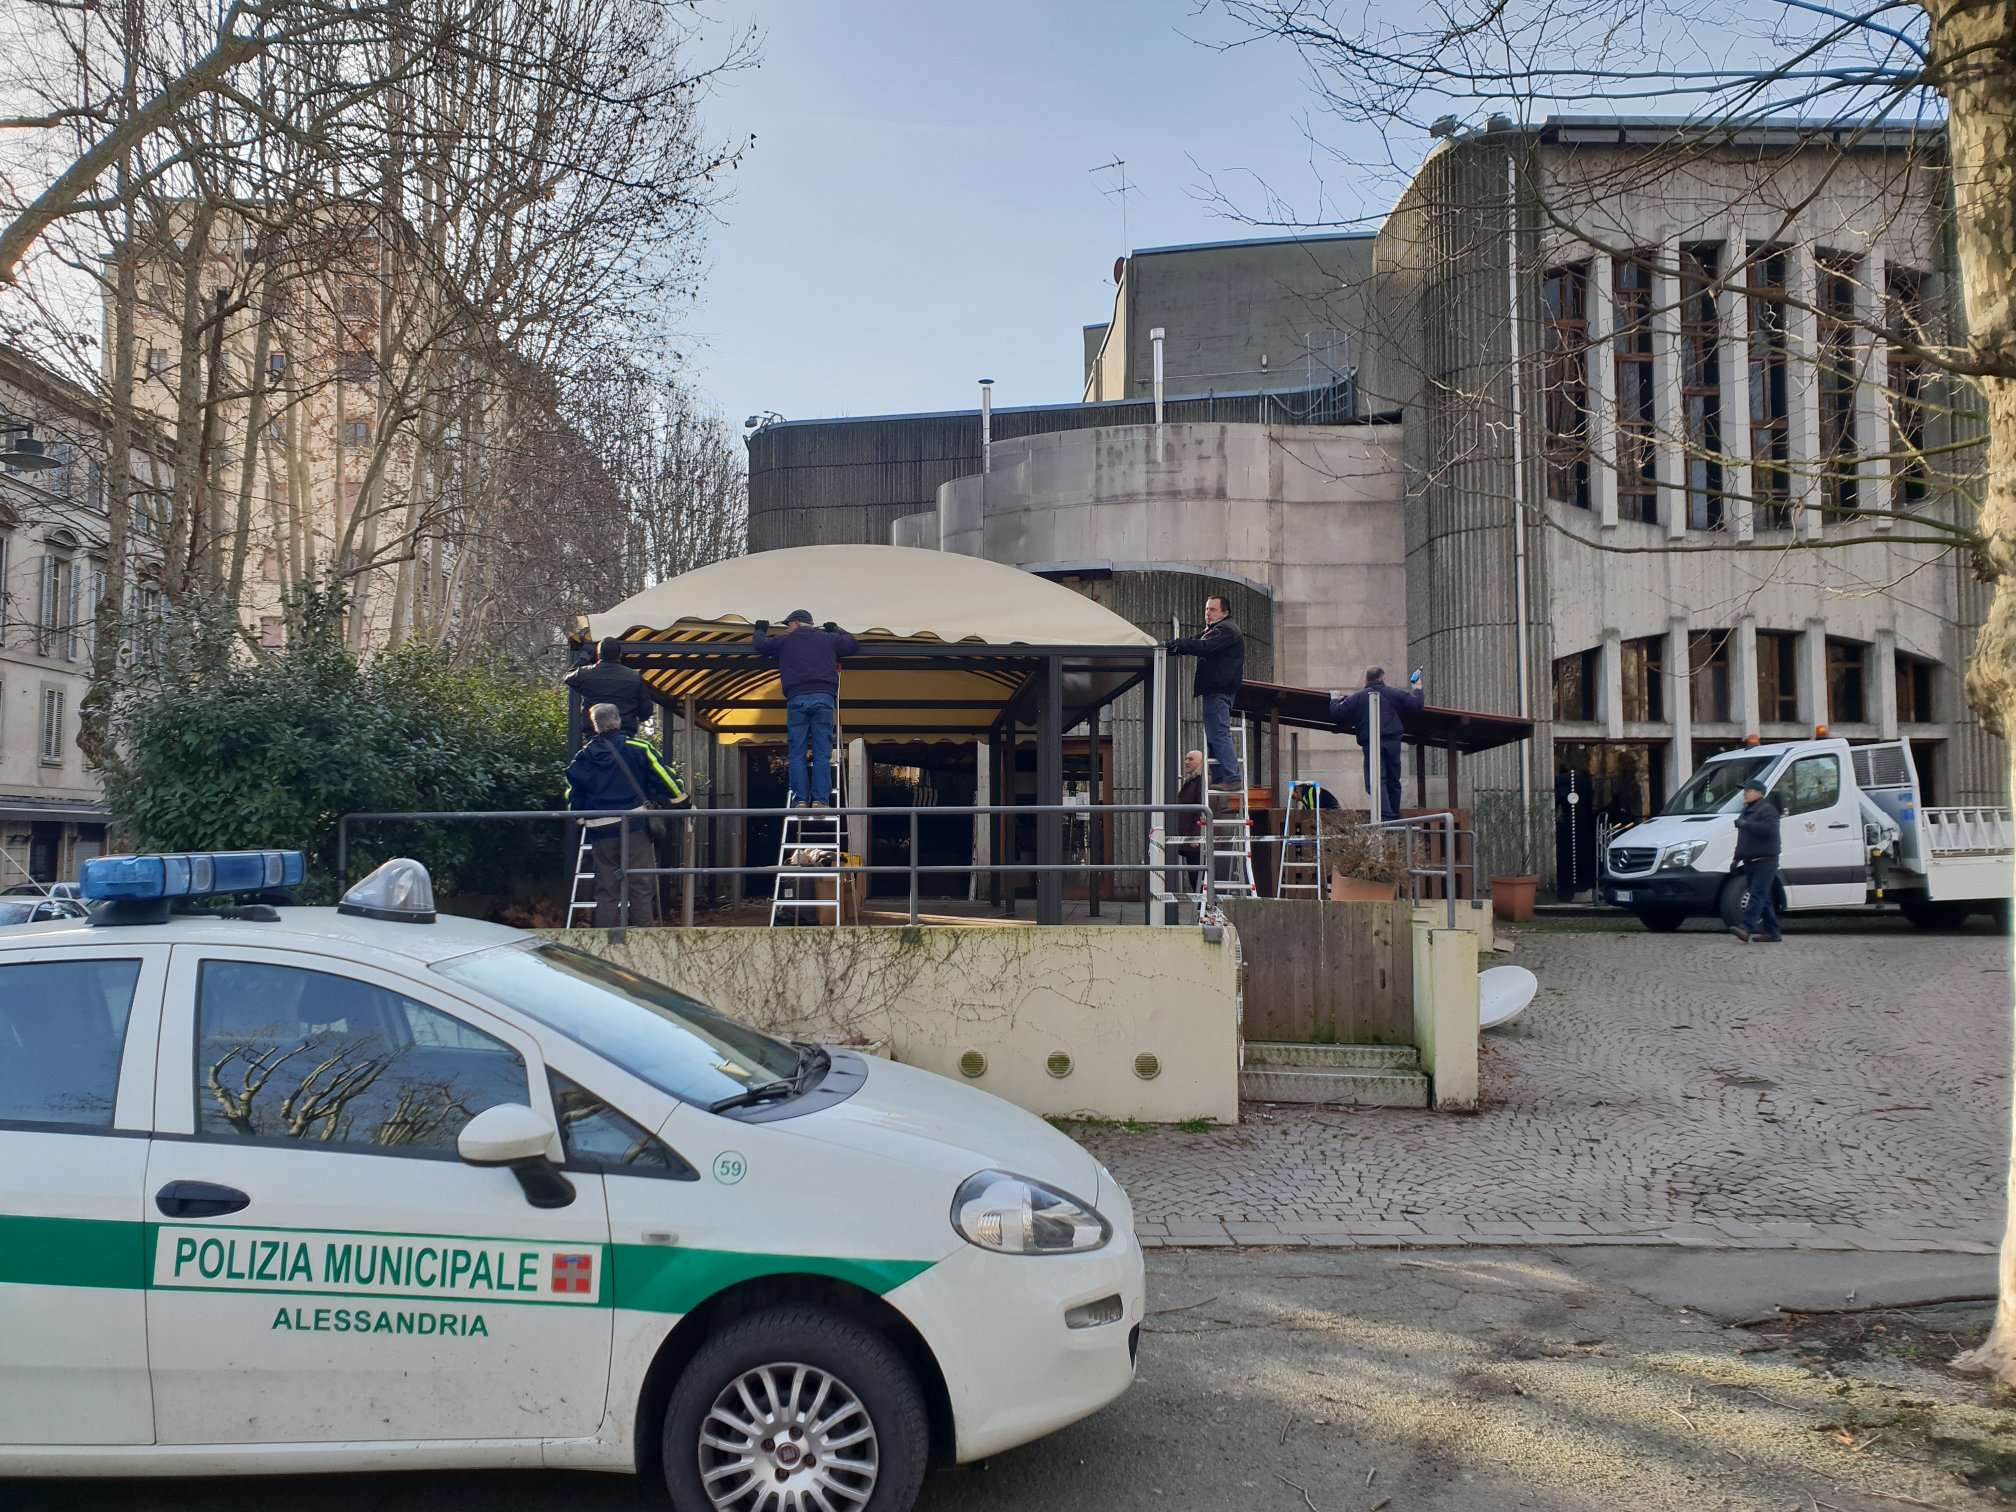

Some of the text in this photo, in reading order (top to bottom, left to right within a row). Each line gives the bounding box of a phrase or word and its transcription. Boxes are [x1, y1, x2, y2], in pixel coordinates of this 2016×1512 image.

[720, 1160, 742, 1176] 59
[174, 1237, 539, 1293] POLIZIA MUNICIPALE
[272, 1307, 489, 1337] ALESSANDRIA
